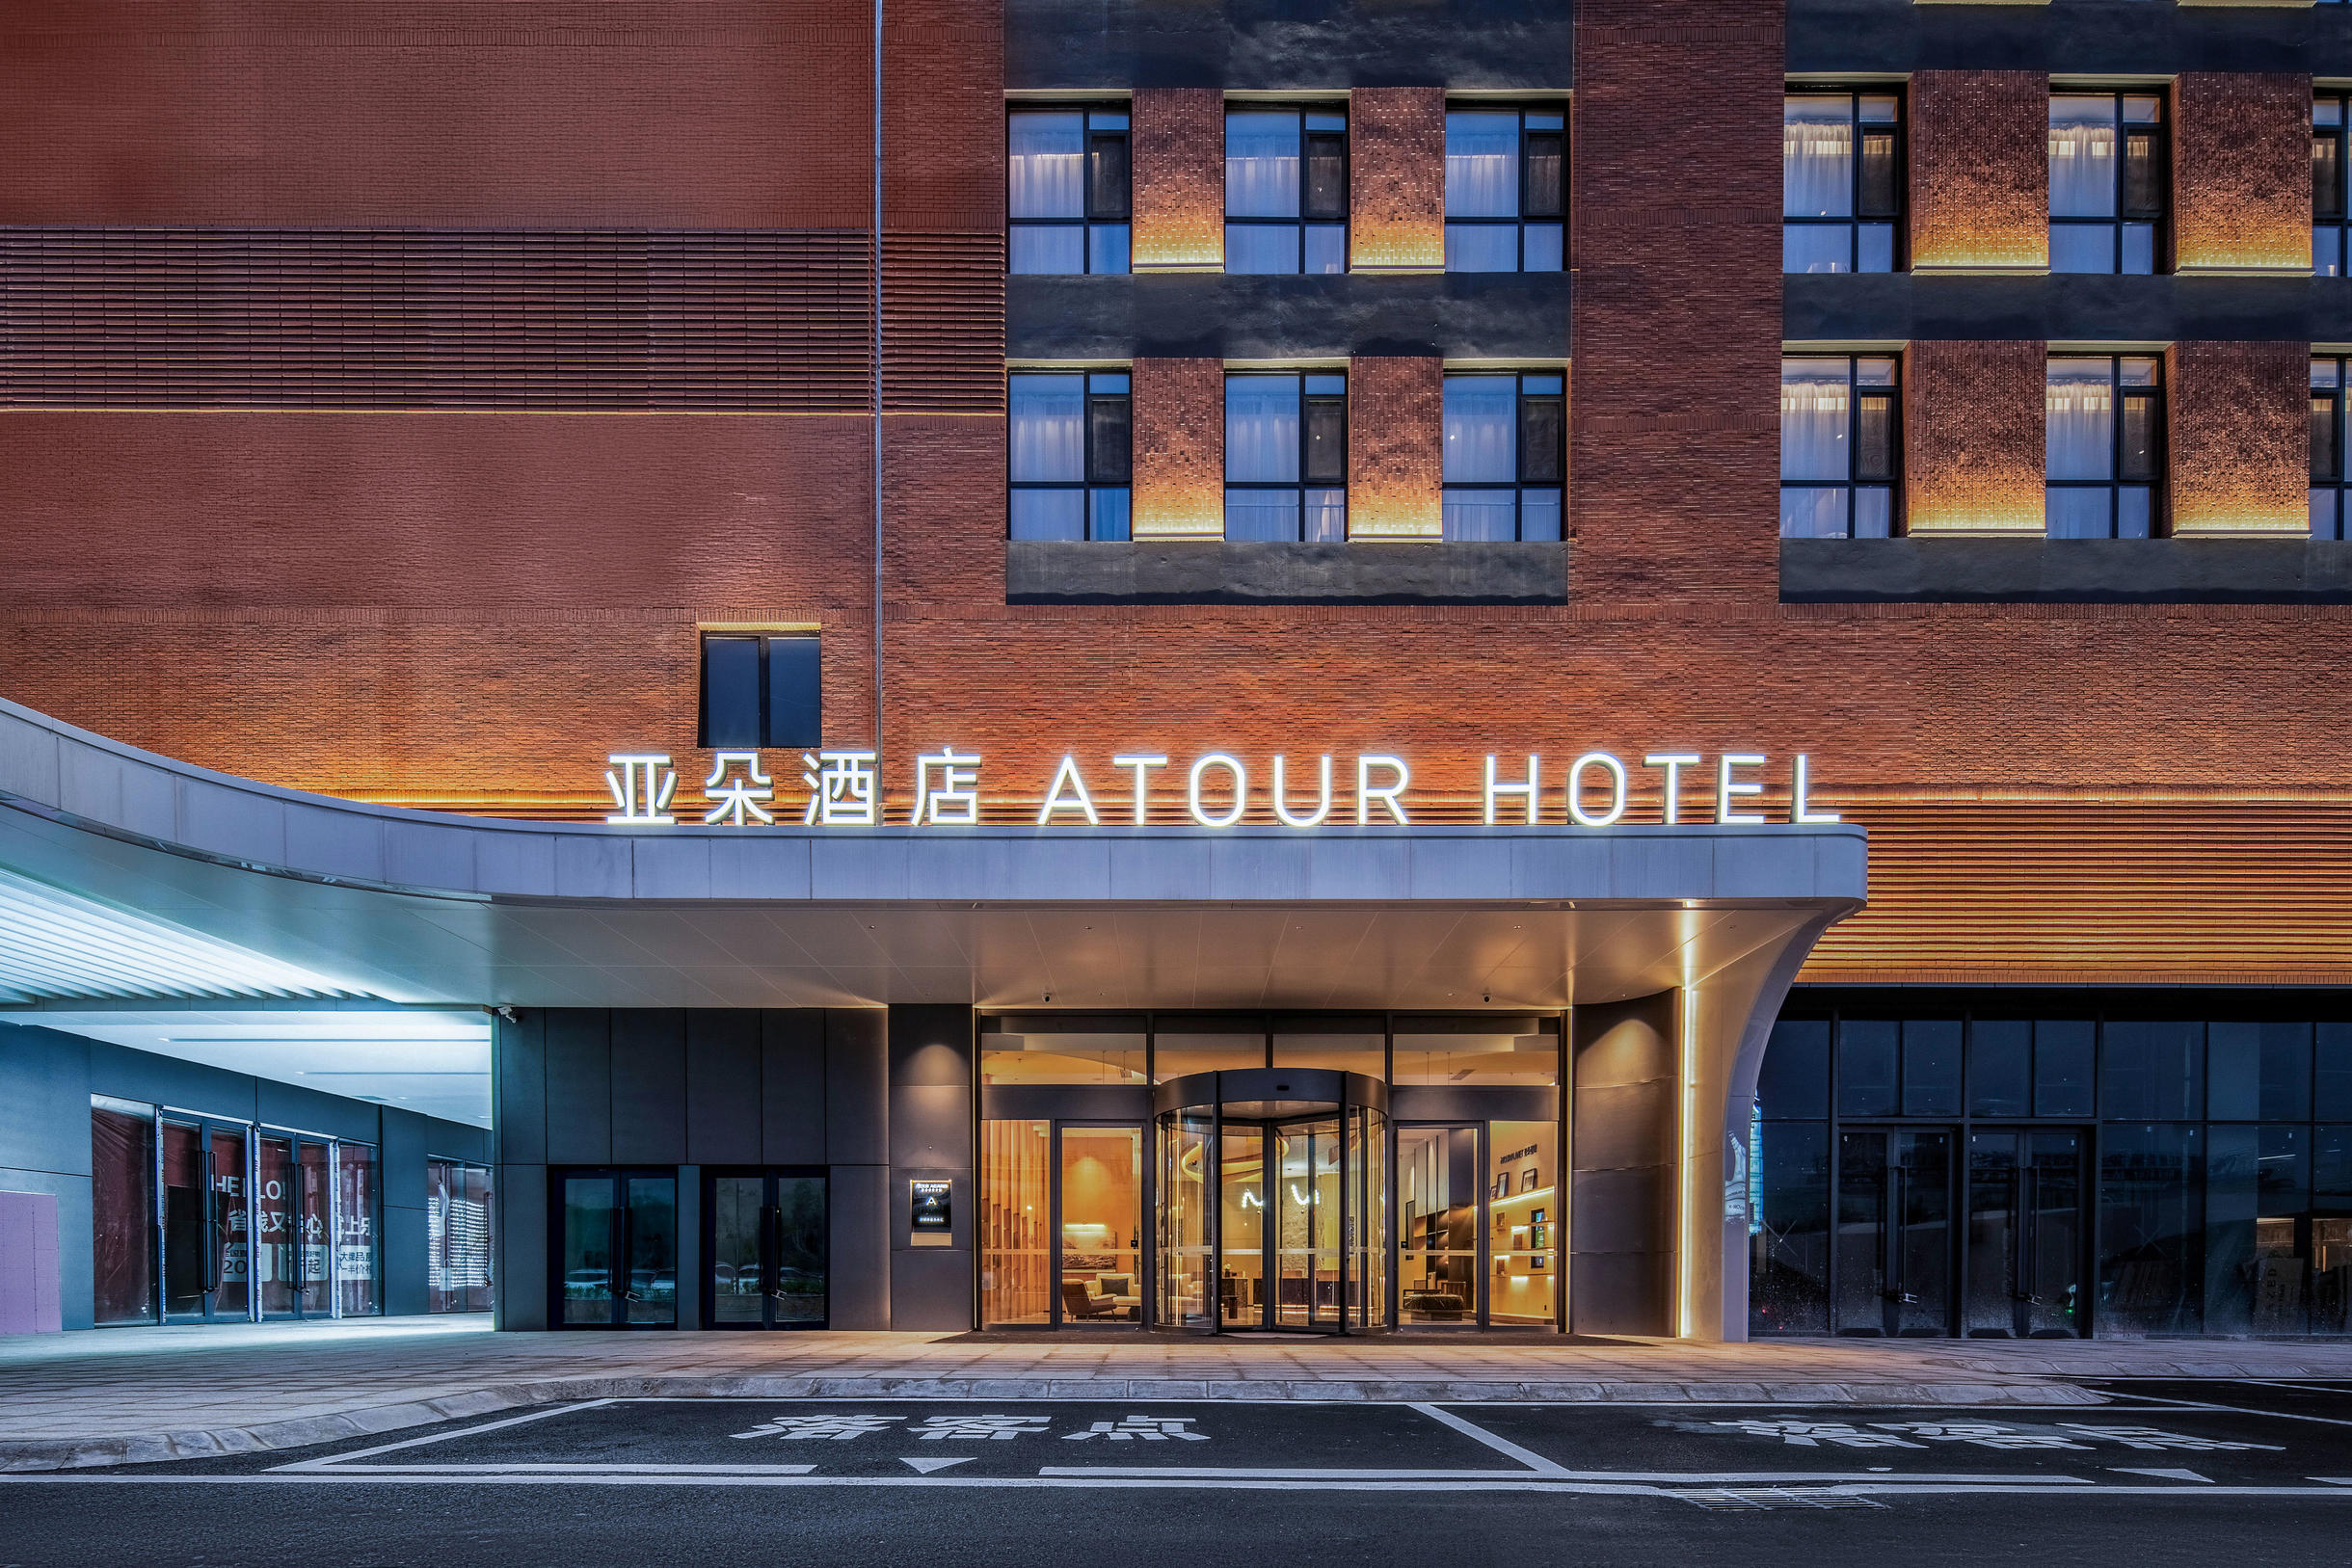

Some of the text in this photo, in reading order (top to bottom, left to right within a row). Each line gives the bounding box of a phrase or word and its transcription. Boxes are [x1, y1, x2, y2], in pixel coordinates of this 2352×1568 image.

[605, 748, 1842, 827] 亚朵酒店 ATOUR HOTEL
[729, 1414, 1212, 1441] 落客点
